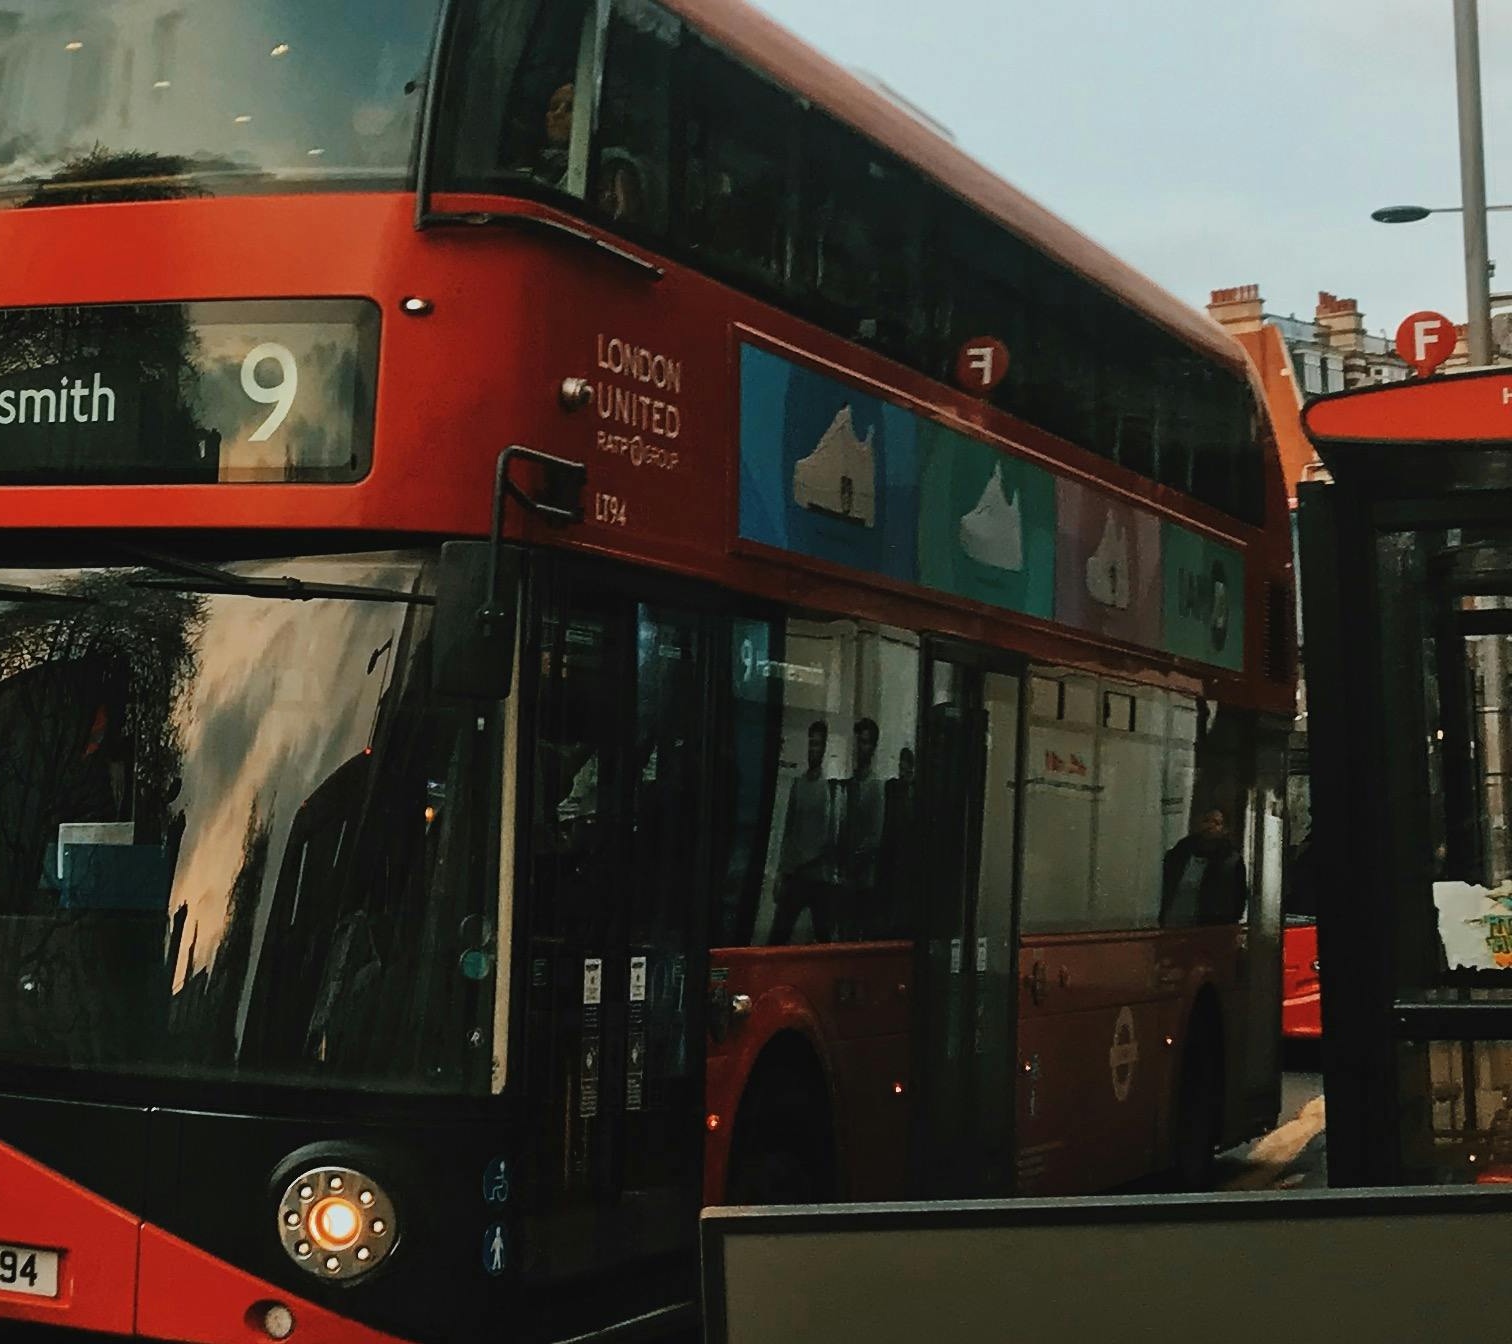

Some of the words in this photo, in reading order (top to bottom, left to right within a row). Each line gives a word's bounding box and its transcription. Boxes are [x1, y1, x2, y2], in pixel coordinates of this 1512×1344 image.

[597, 333, 681, 394] LONDON
[1414, 320, 1441, 361] F
[240, 342, 298, 443] 9
[597, 381, 681, 439] UNITED
[595, 492, 627, 527] LT94
